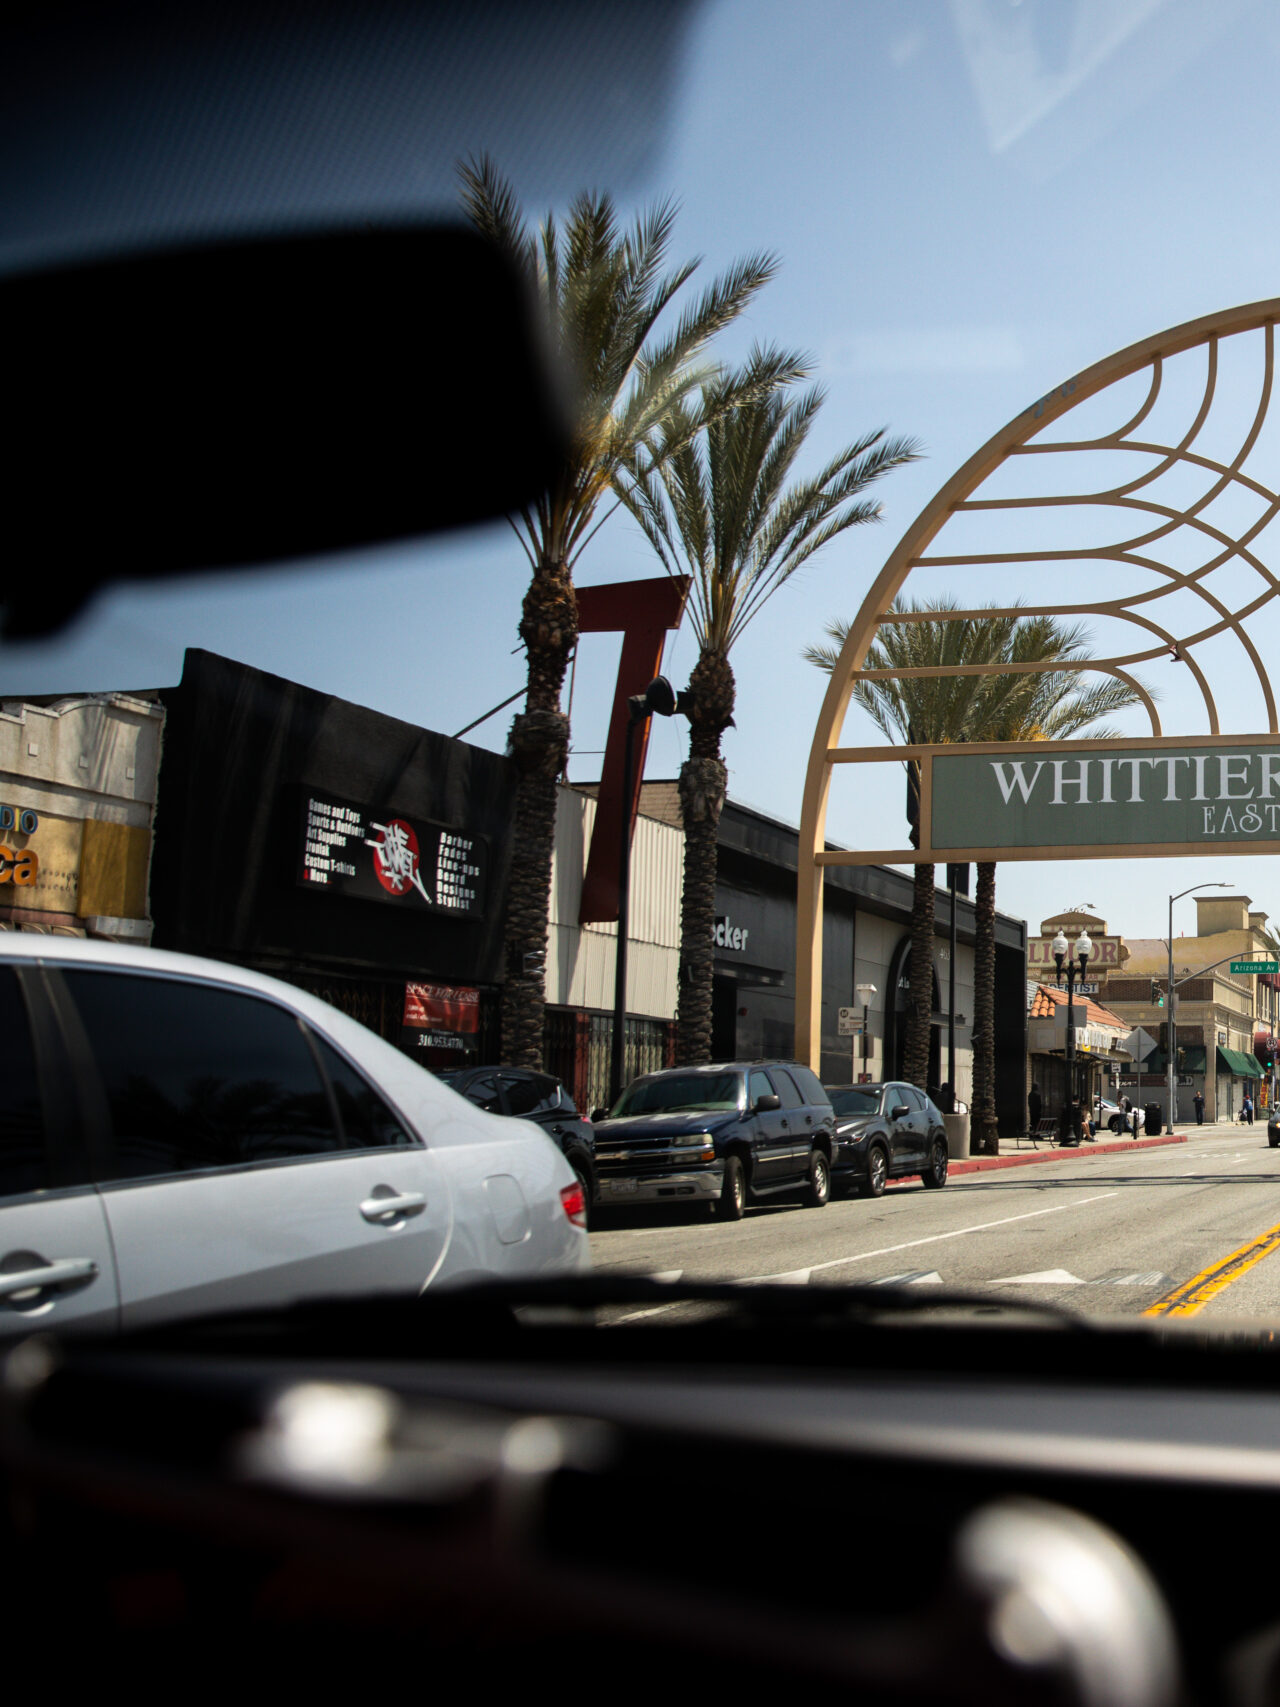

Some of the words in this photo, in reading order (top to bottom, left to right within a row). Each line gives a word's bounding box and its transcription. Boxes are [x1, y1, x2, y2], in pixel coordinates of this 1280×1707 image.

[309, 798, 331, 816] Games
[331, 805, 345, 819] and
[345, 807, 360, 824] Toys
[308, 811, 330, 829] Sports
[330, 818, 335, 831] &
[336, 819, 365, 838] Outdoors
[306, 826, 317, 840] Art
[317, 828, 347, 847] Supplies
[440, 832, 473, 851] Barber
[438, 843, 467, 862] Fades
[304, 854, 330, 871] Custom
[330, 859, 356, 877] T-shirts
[437, 856, 480, 876] Line-ups
[436, 869, 466, 885] Beard
[436, 880, 475, 899] Designs
[436, 892, 469, 910] Stylist
[1234, 964, 1262, 972] Arizona
[1266, 964, 1275, 972] Av
